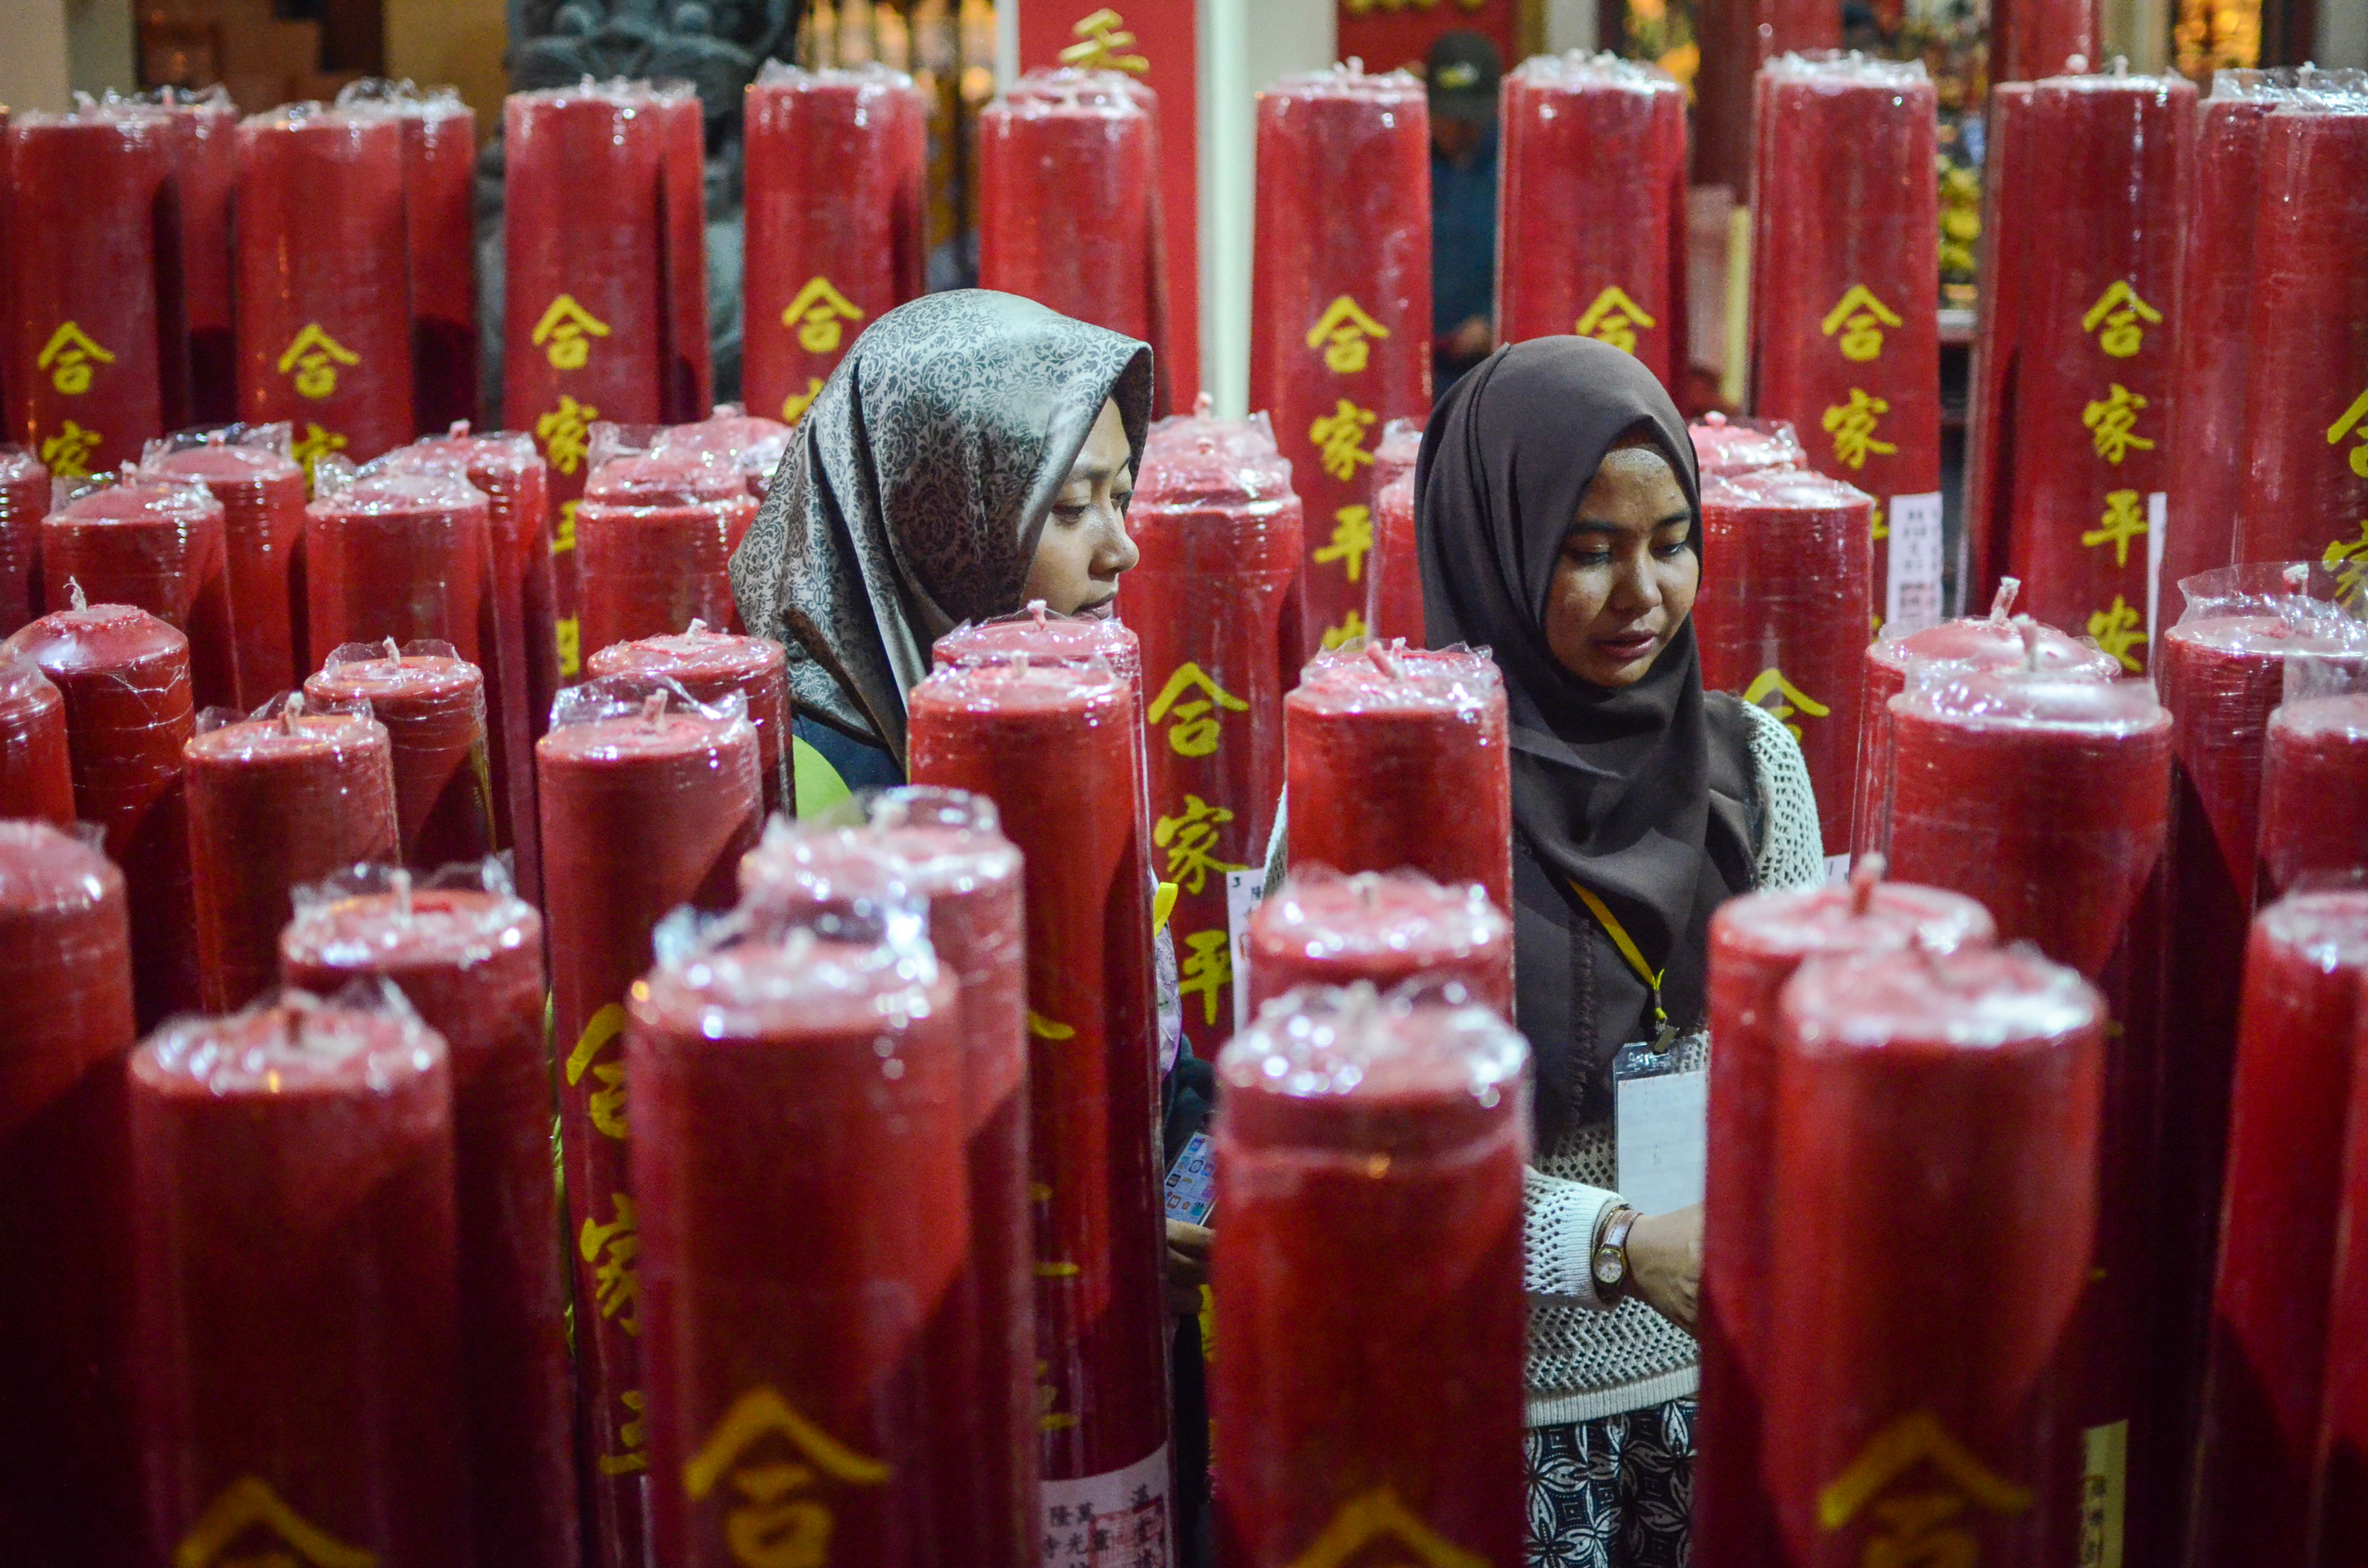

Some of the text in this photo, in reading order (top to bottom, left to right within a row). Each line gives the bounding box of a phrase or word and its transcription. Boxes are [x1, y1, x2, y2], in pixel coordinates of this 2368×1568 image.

[2083, 281, 2163, 672] 合家平安
[684, 1386, 891, 1568] 合
